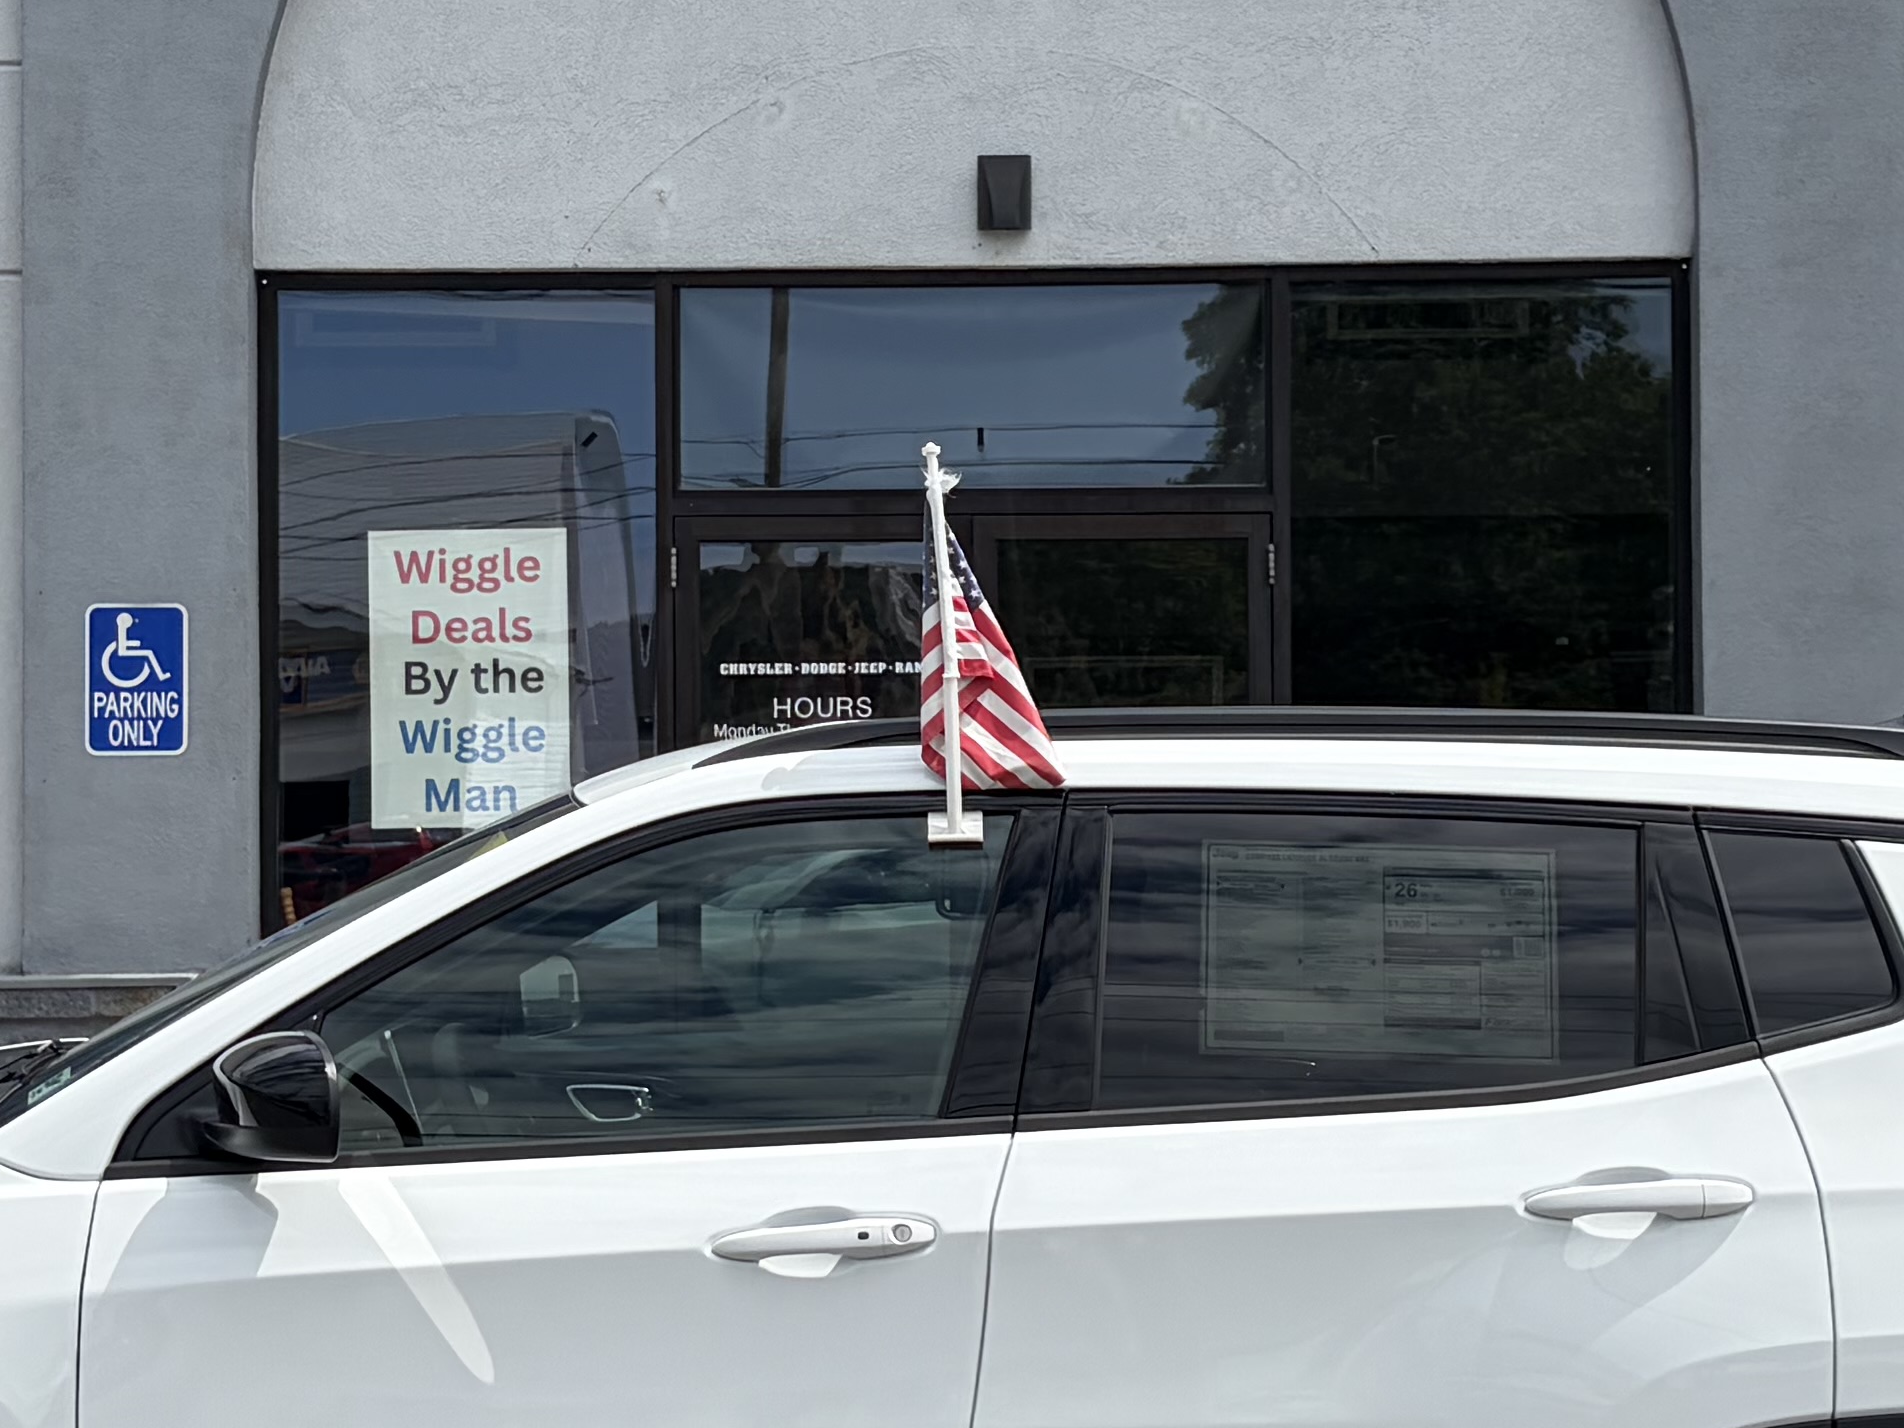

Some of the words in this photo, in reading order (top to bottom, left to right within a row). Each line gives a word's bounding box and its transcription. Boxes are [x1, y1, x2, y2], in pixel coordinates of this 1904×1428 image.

[393, 548, 541, 593] Wiggle
[411, 608, 533, 644] Deals
[404, 661, 459, 705] By
[471, 657, 545, 694] the
[93, 691, 179, 718] PARKING
[772, 696, 873, 719] HOURS
[108, 719, 163, 747] ONLY
[398, 717, 546, 763] Wiggle
[424, 778, 519, 813] Man
[1394, 882, 1418, 899] 26
